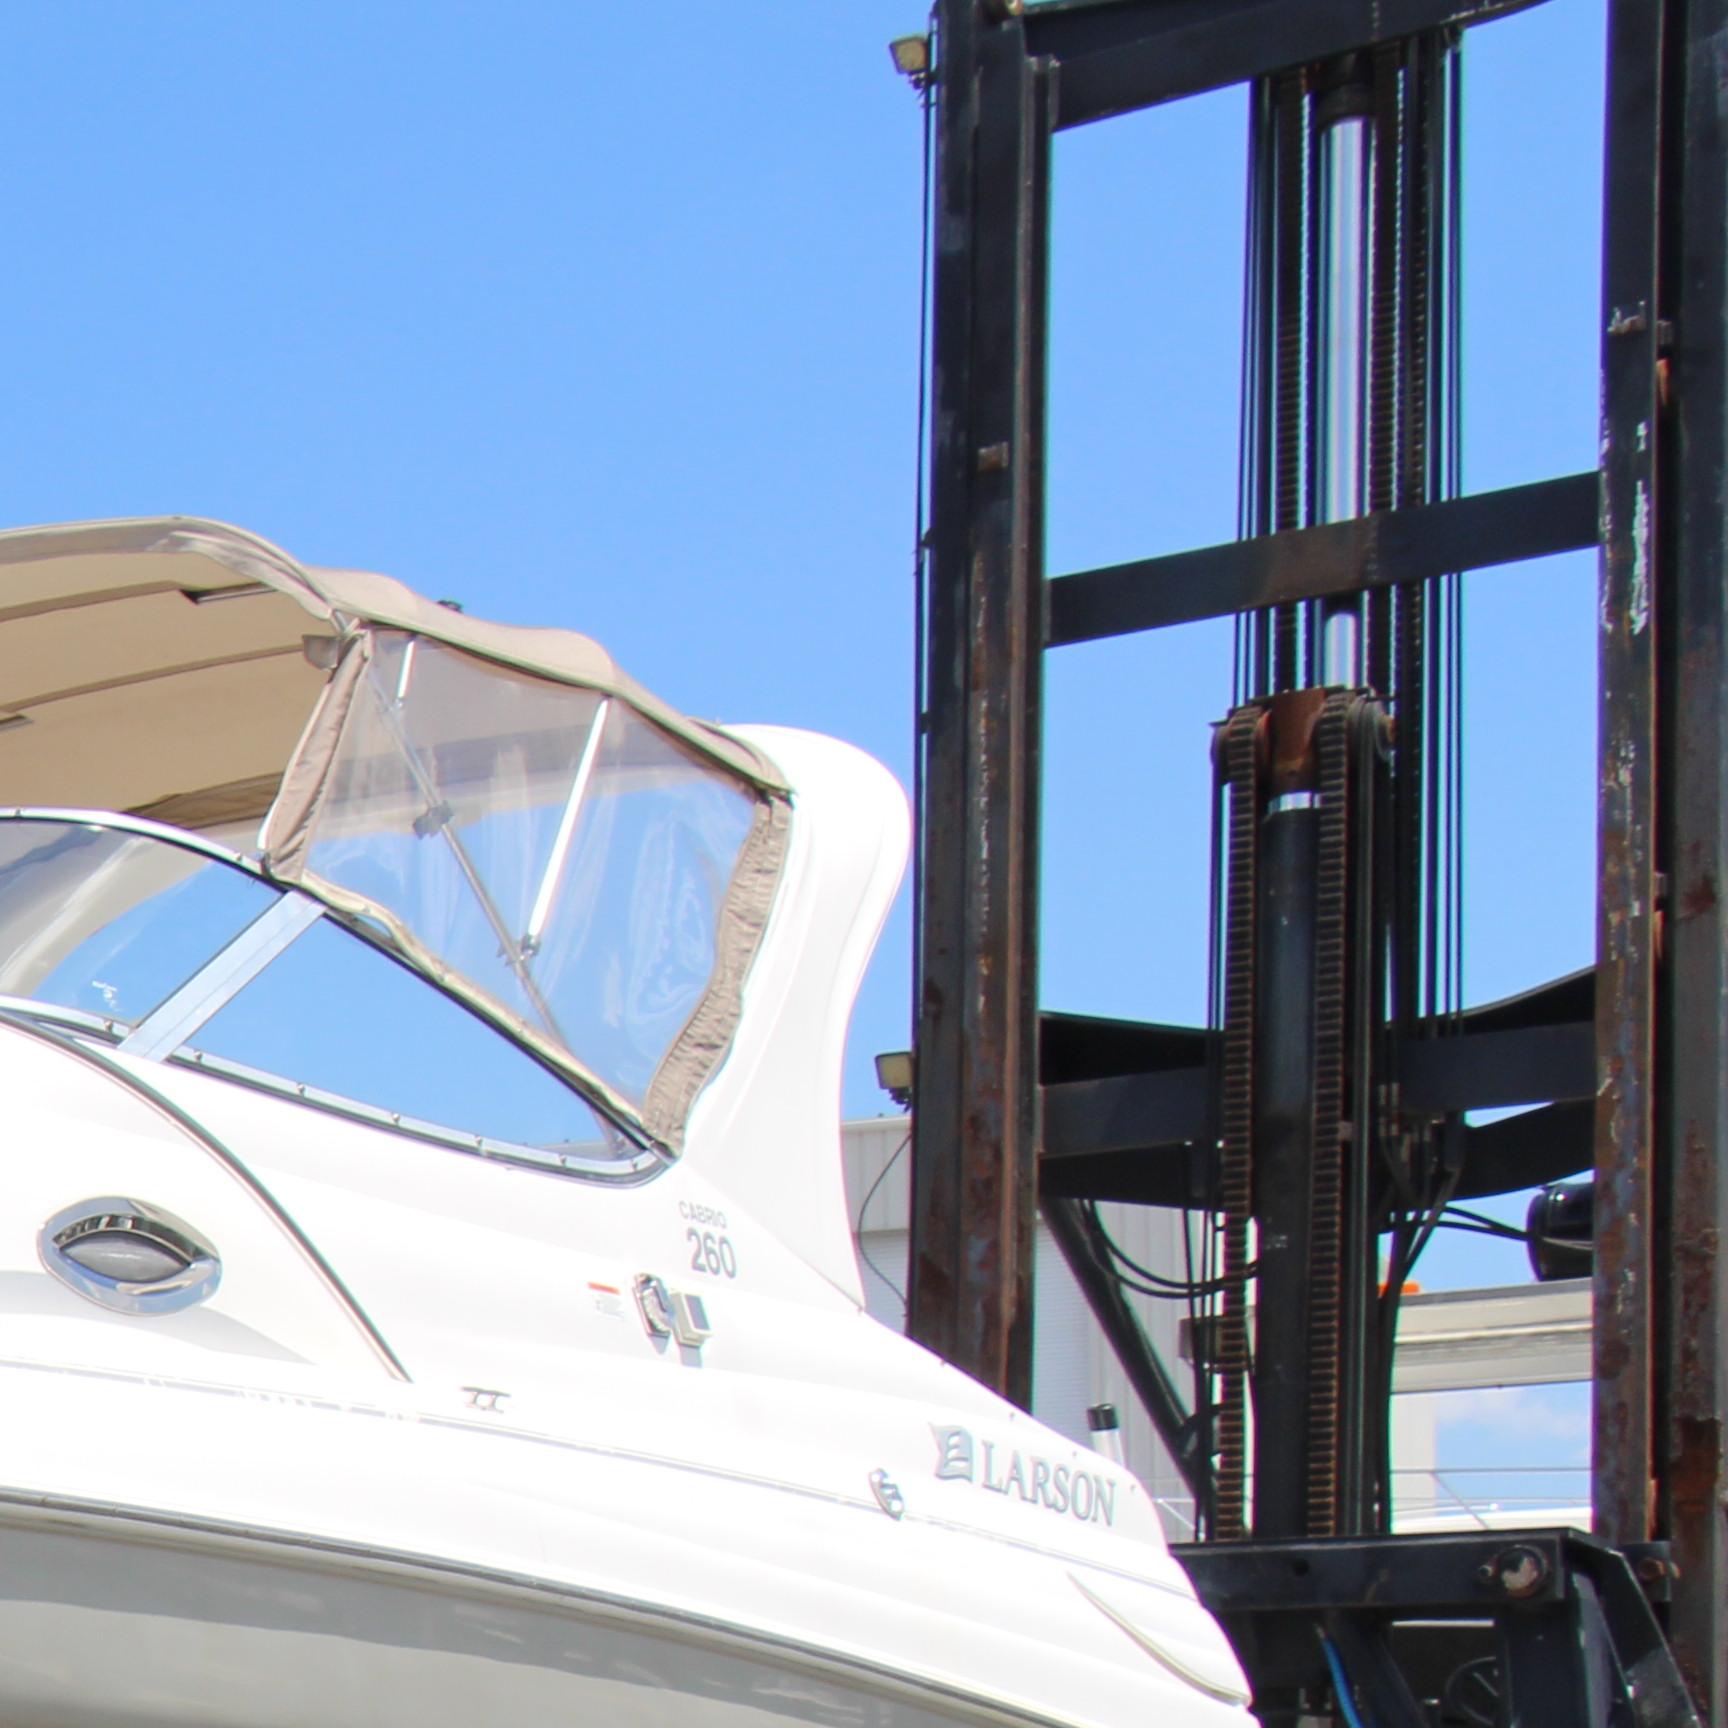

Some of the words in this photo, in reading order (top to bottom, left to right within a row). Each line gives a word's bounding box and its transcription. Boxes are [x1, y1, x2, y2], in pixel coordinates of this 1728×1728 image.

[678, 1200, 727, 1230] CABRIO
[686, 1226, 737, 1279] 260
[981, 1439, 1118, 1528] LARSON
